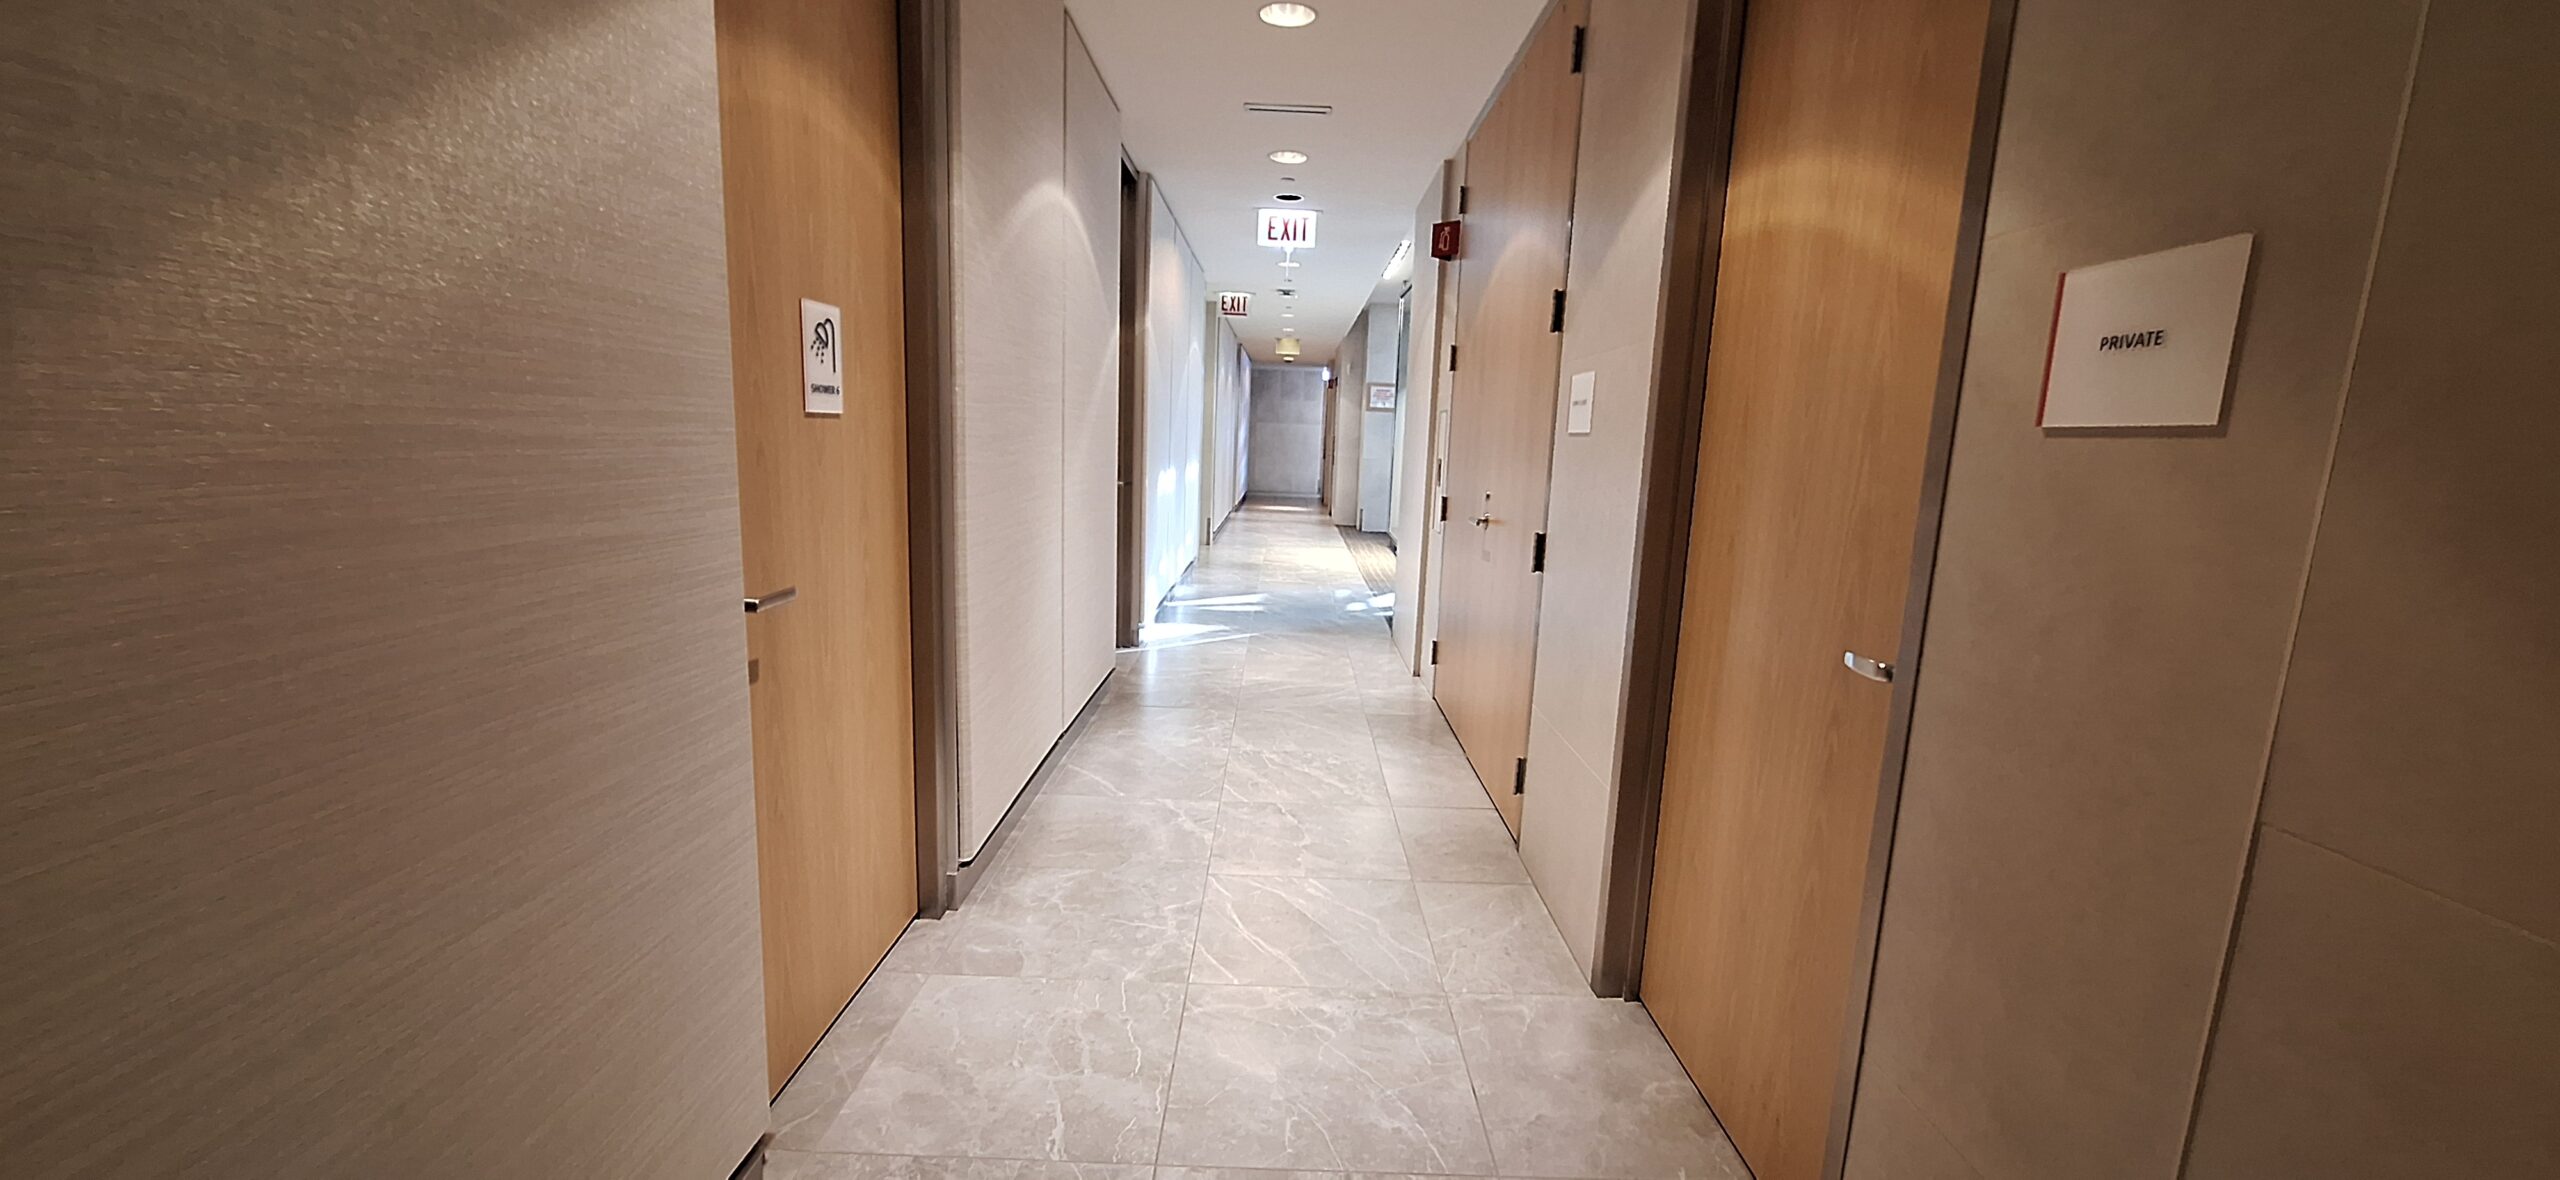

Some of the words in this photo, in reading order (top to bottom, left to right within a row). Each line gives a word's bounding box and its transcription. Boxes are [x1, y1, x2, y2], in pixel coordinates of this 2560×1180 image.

[1267, 216, 1310, 241] EXIT
[1221, 295, 1248, 312] EXIT
[2099, 330, 2164, 351] PRIVATE
[810, 383, 835, 395] SHOWER
